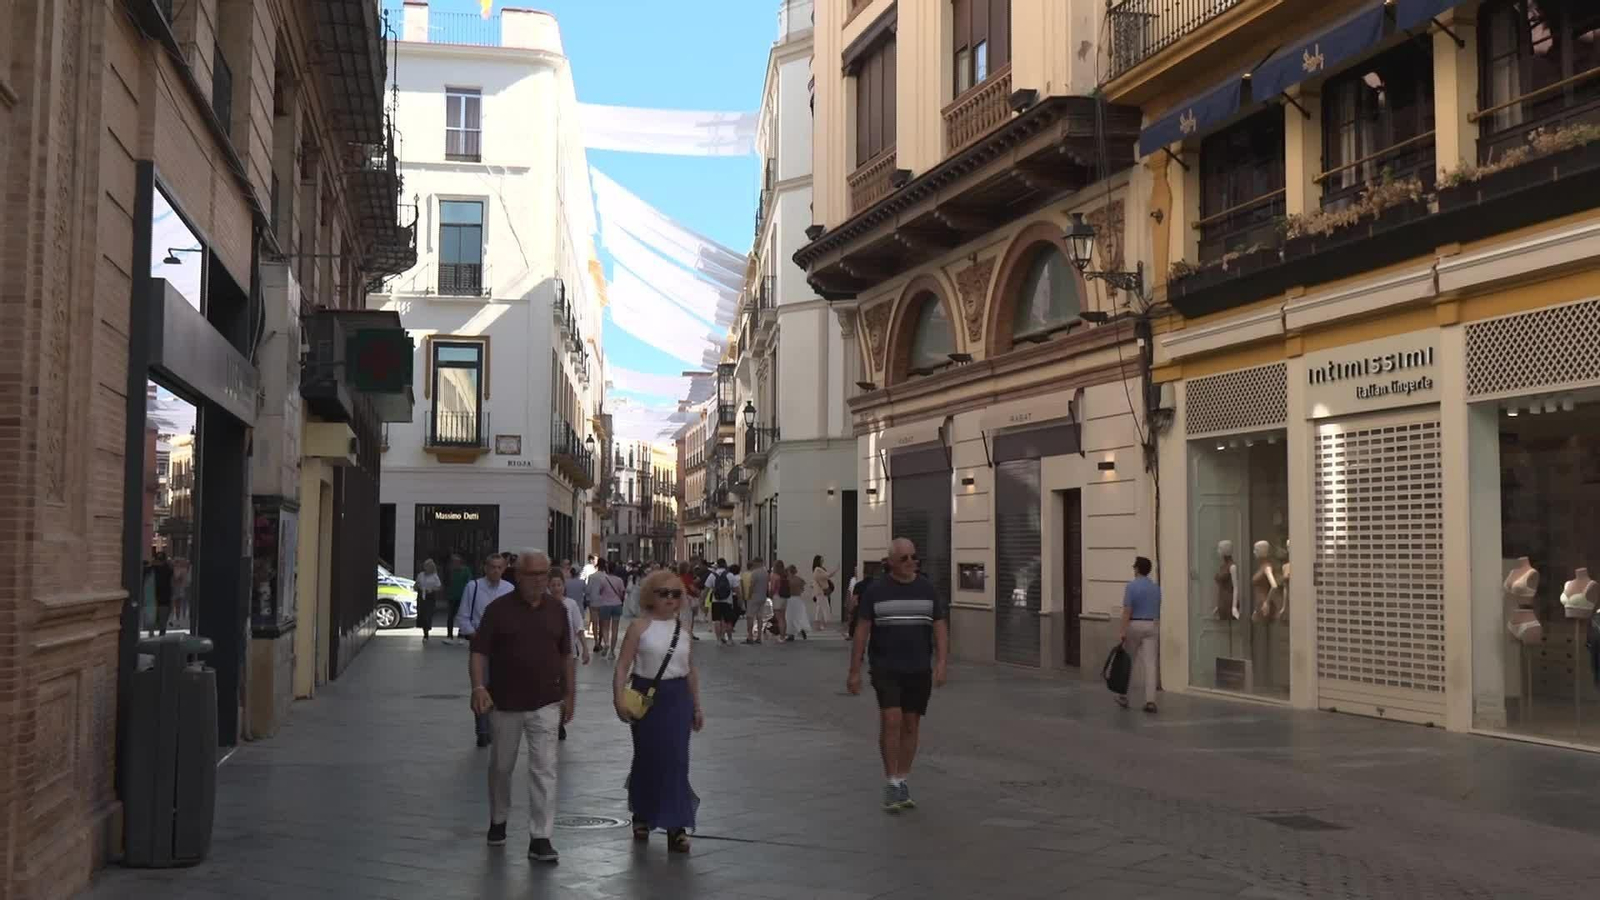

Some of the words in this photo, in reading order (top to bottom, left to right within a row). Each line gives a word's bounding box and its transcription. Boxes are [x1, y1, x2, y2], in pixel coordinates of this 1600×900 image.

[1391, 376, 1433, 396] lingerie
[435, 511, 462, 520] Massimo
[463, 511, 479, 520] Dutti
